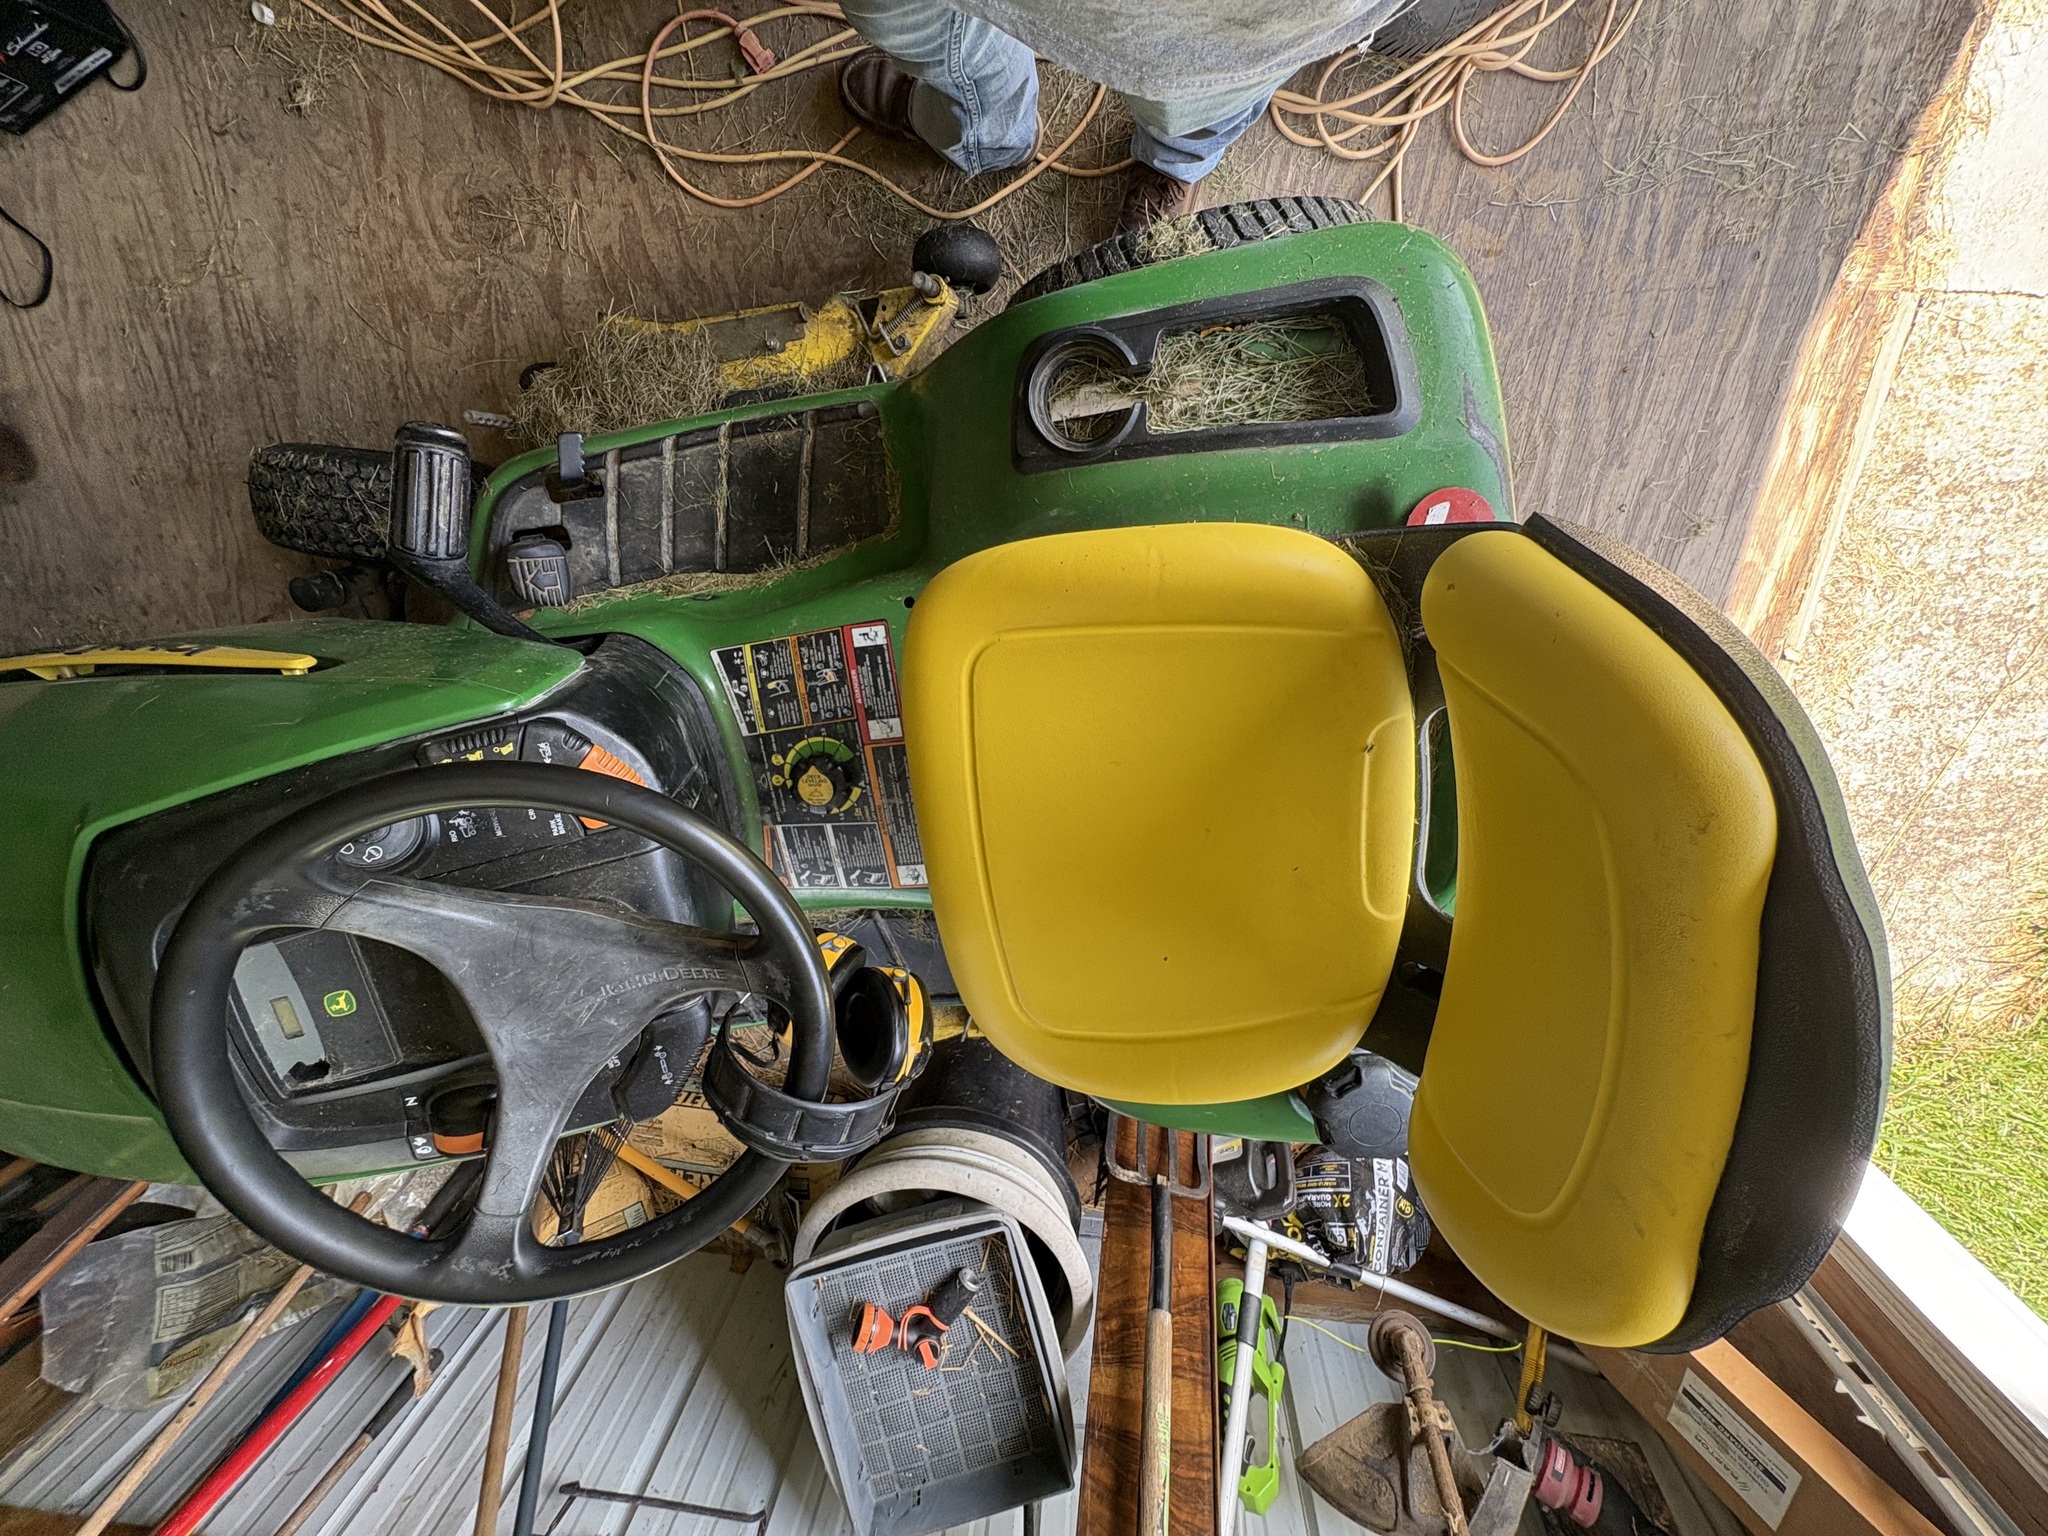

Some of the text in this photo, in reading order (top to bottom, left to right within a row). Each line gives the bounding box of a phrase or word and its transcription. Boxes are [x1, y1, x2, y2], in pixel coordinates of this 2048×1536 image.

[549, 819, 559, 837] PARK
[554, 812, 566, 835] BRAKE
[449, 830, 458, 843] RIO
[662, 966, 728, 982] DEERE
[1312, 1194, 1351, 1208] 2X MORE
[1716, 1423, 1765, 1472] STANDARD
[1693, 1433, 1739, 1481] RAPTOR
